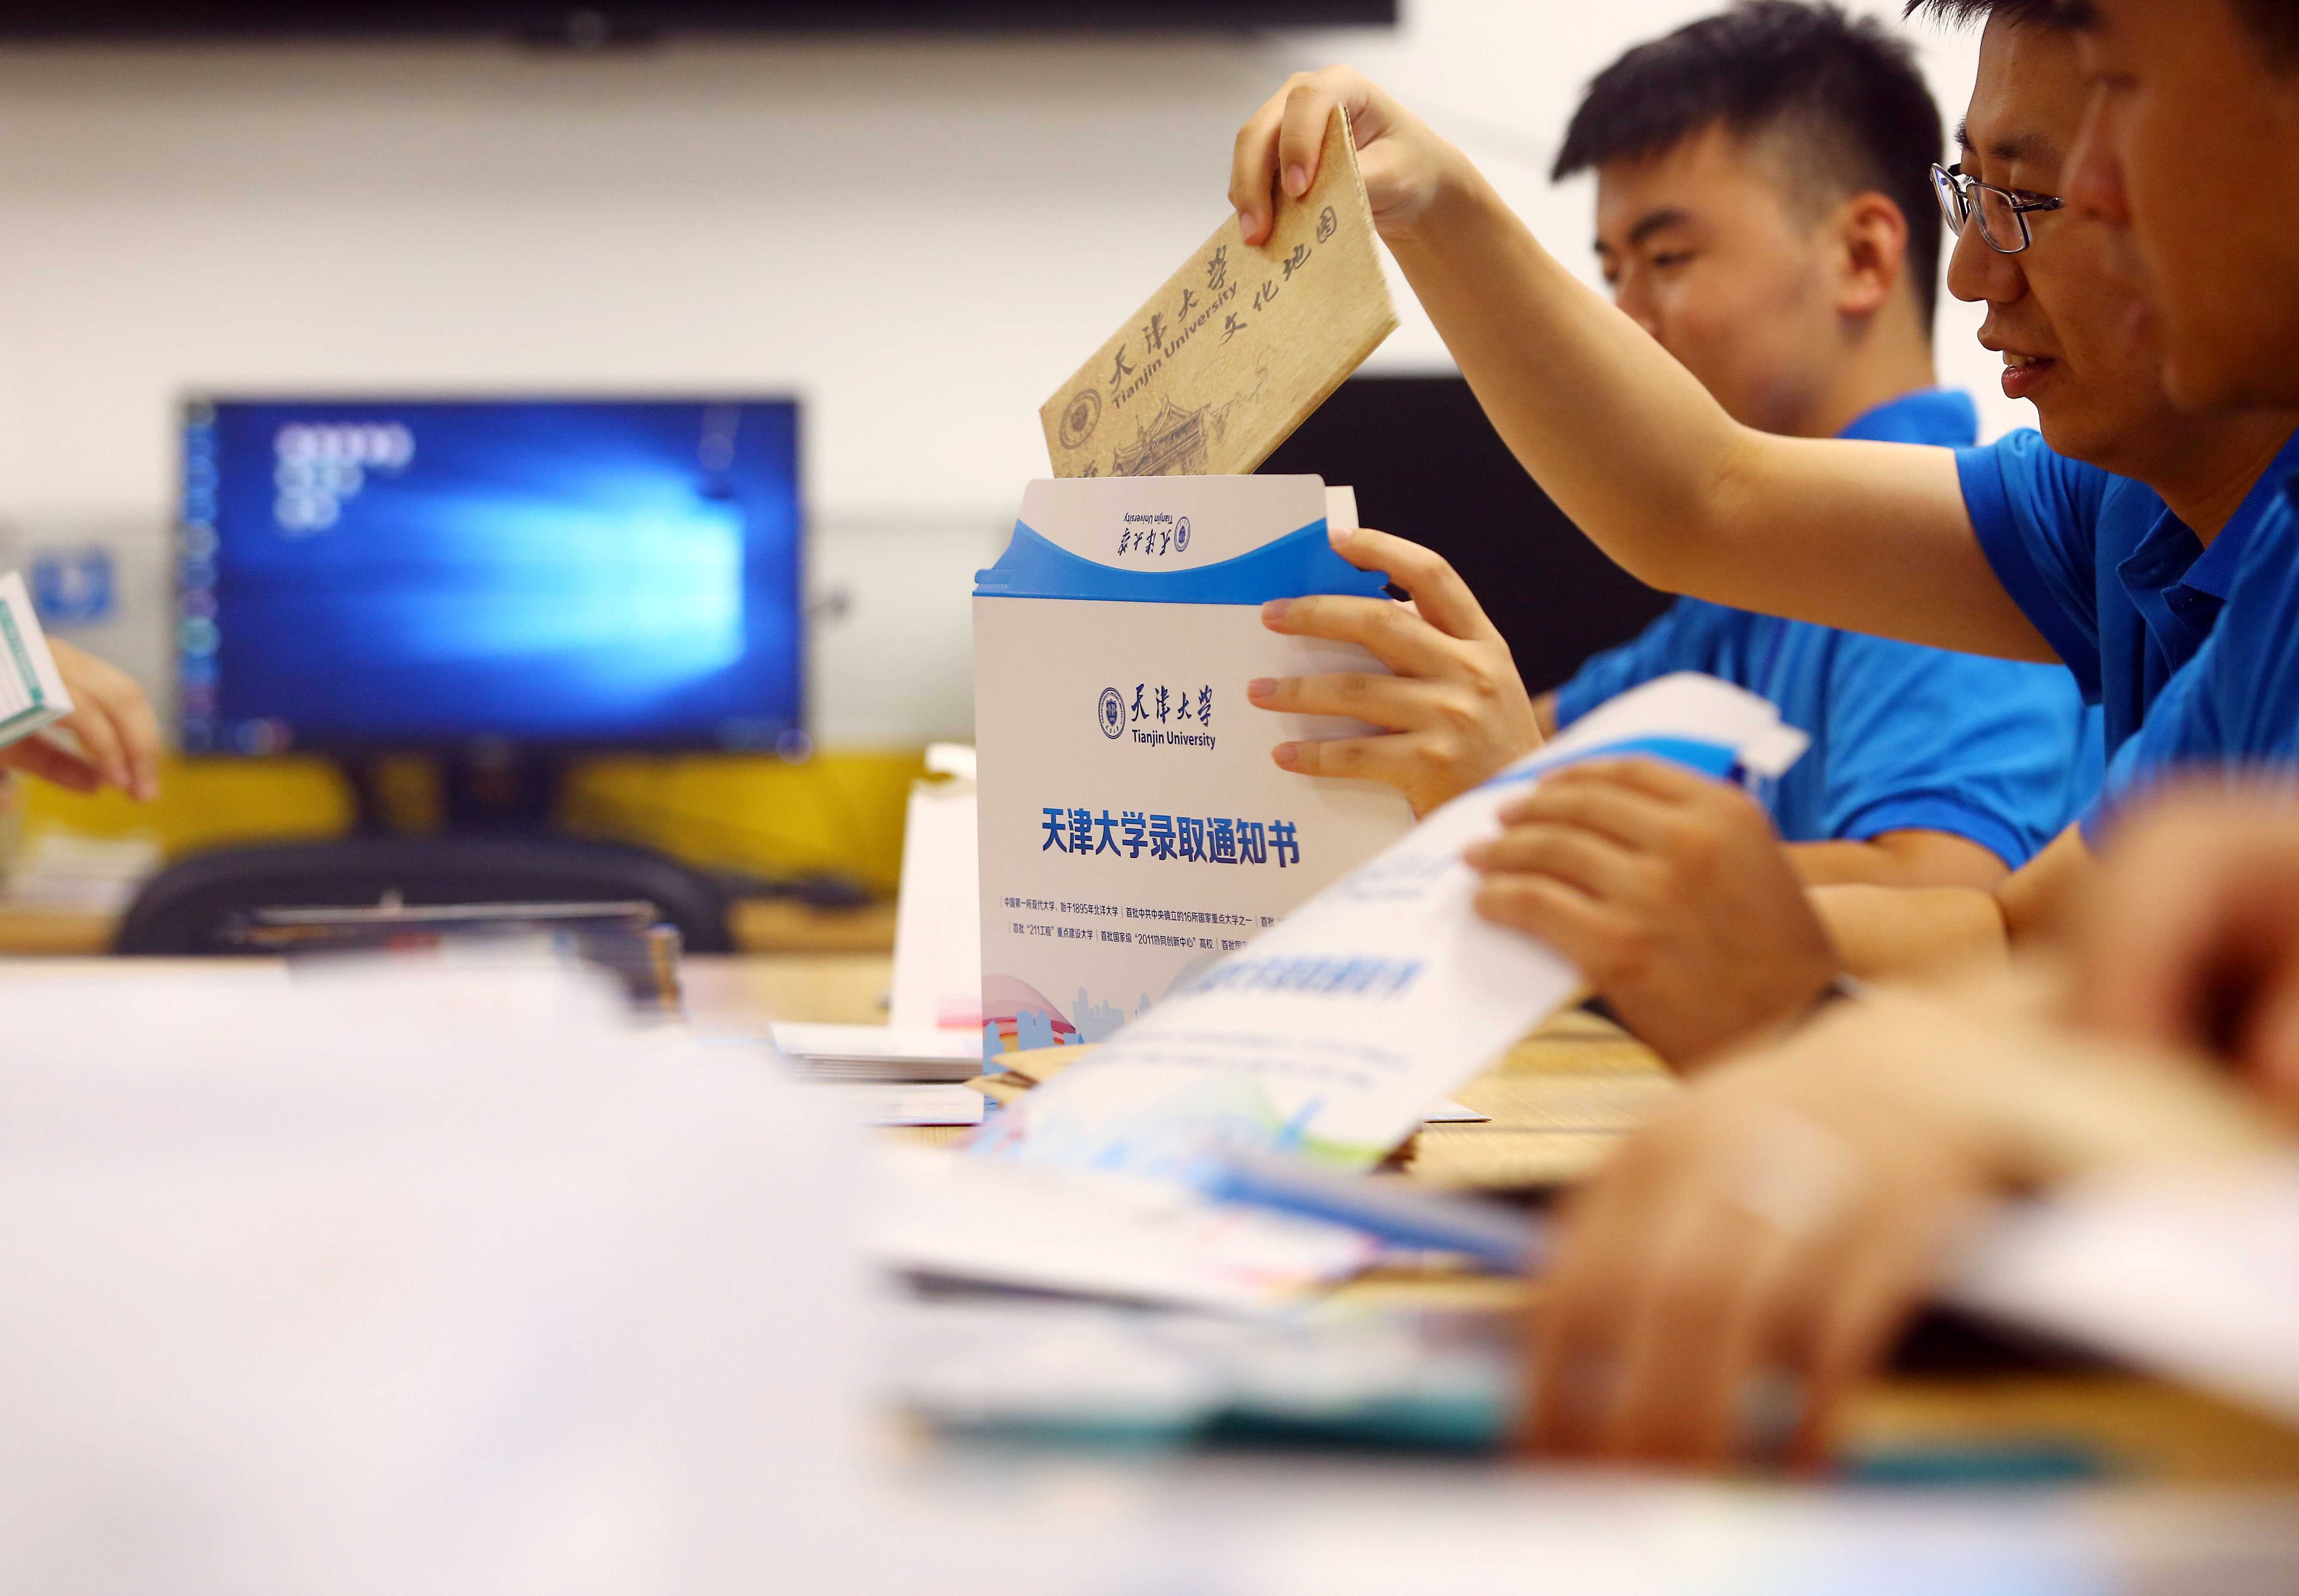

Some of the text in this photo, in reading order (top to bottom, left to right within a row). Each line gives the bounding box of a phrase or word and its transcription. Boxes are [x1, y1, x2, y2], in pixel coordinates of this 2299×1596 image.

[1111, 281, 1237, 409] Tianjin University
[1123, 512, 1173, 524] Tianjin University
[1131, 683, 1212, 727] 天津大学
[1132, 729, 1216, 750] Tianjin University
[1042, 807, 1301, 868] 天津大学录取通知书
